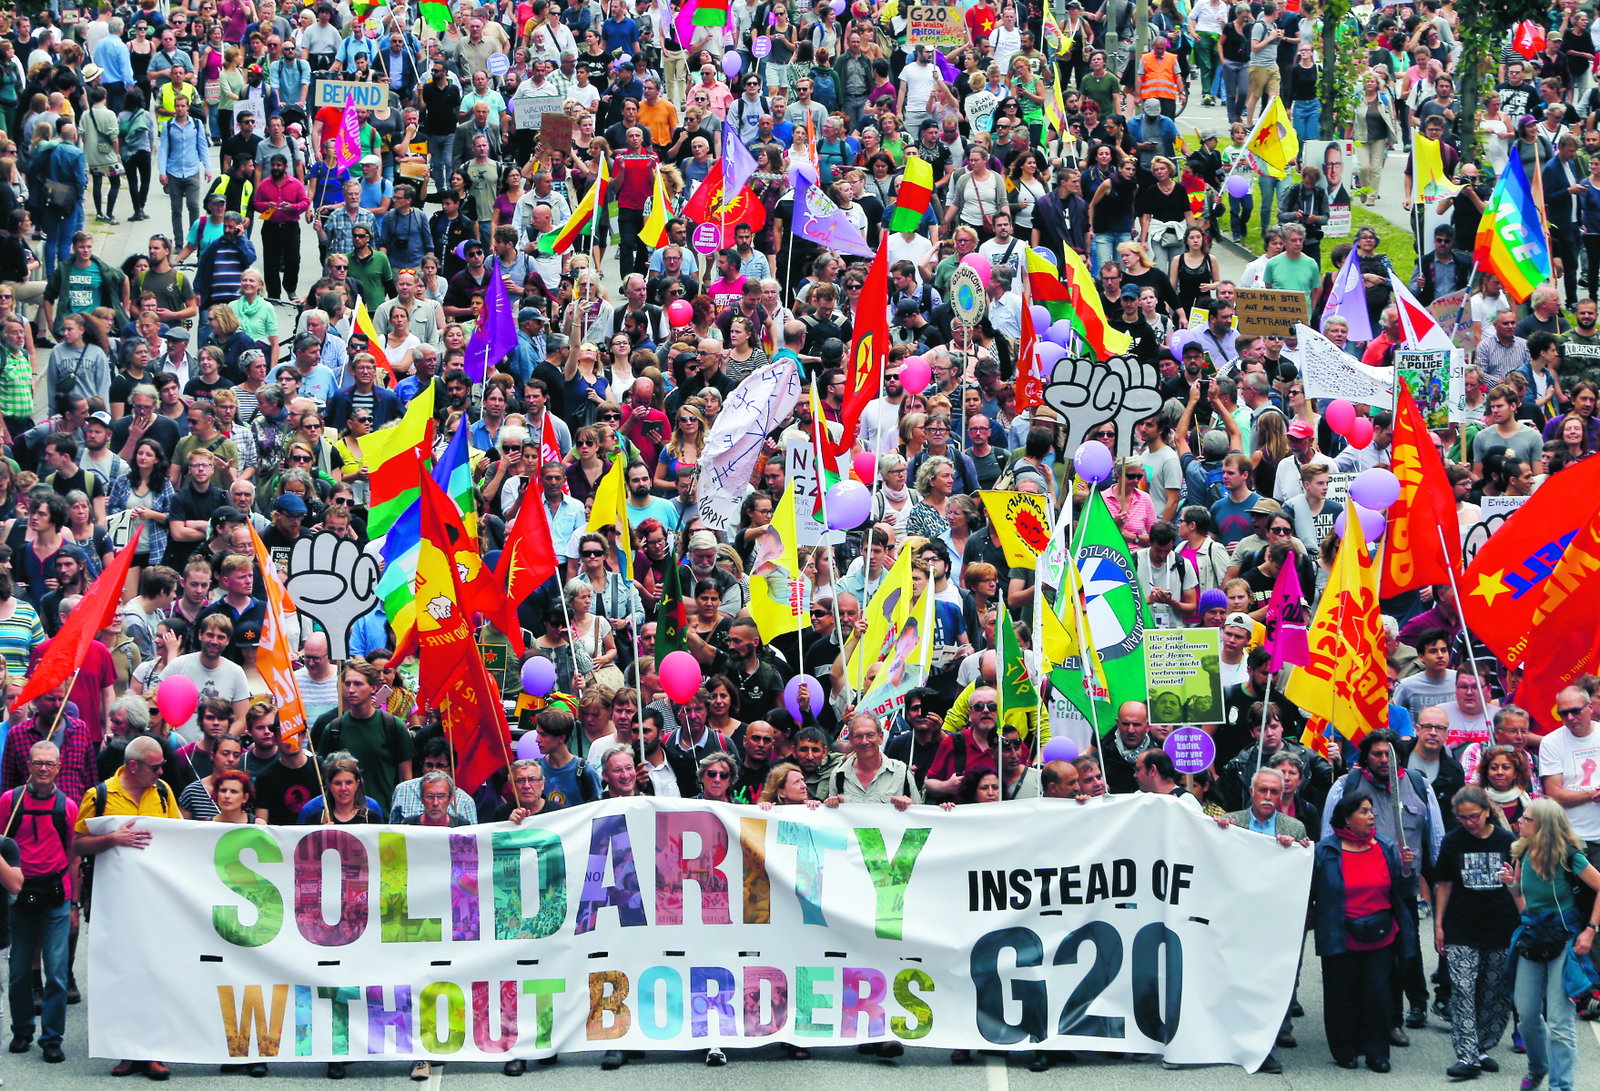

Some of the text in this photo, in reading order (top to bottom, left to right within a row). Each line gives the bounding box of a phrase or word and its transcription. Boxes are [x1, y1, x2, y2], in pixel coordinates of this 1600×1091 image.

[1259, 293, 1276, 301] MICH
[1281, 294, 1300, 302] BITTE
[1401, 354, 1420, 363] FUCK
[1407, 359, 1443, 370] POLICE
[1124, 570, 1141, 598] OUT
[1149, 634, 1163, 642] Wir
[1165, 642, 1209, 651] Enkelinnen
[1151, 668, 1196, 676] verbrennen
[1151, 677, 1185, 686] konntet!
[1174, 733, 1203, 743] Her yer
[1175, 750, 1203, 759] her yer
[212, 811, 932, 947] SOLIDARITY
[967, 858, 1195, 912] INSTEAD OF
[970, 920, 1183, 1046] G20
[217, 966, 935, 1057] WITHOUT BORDERS
